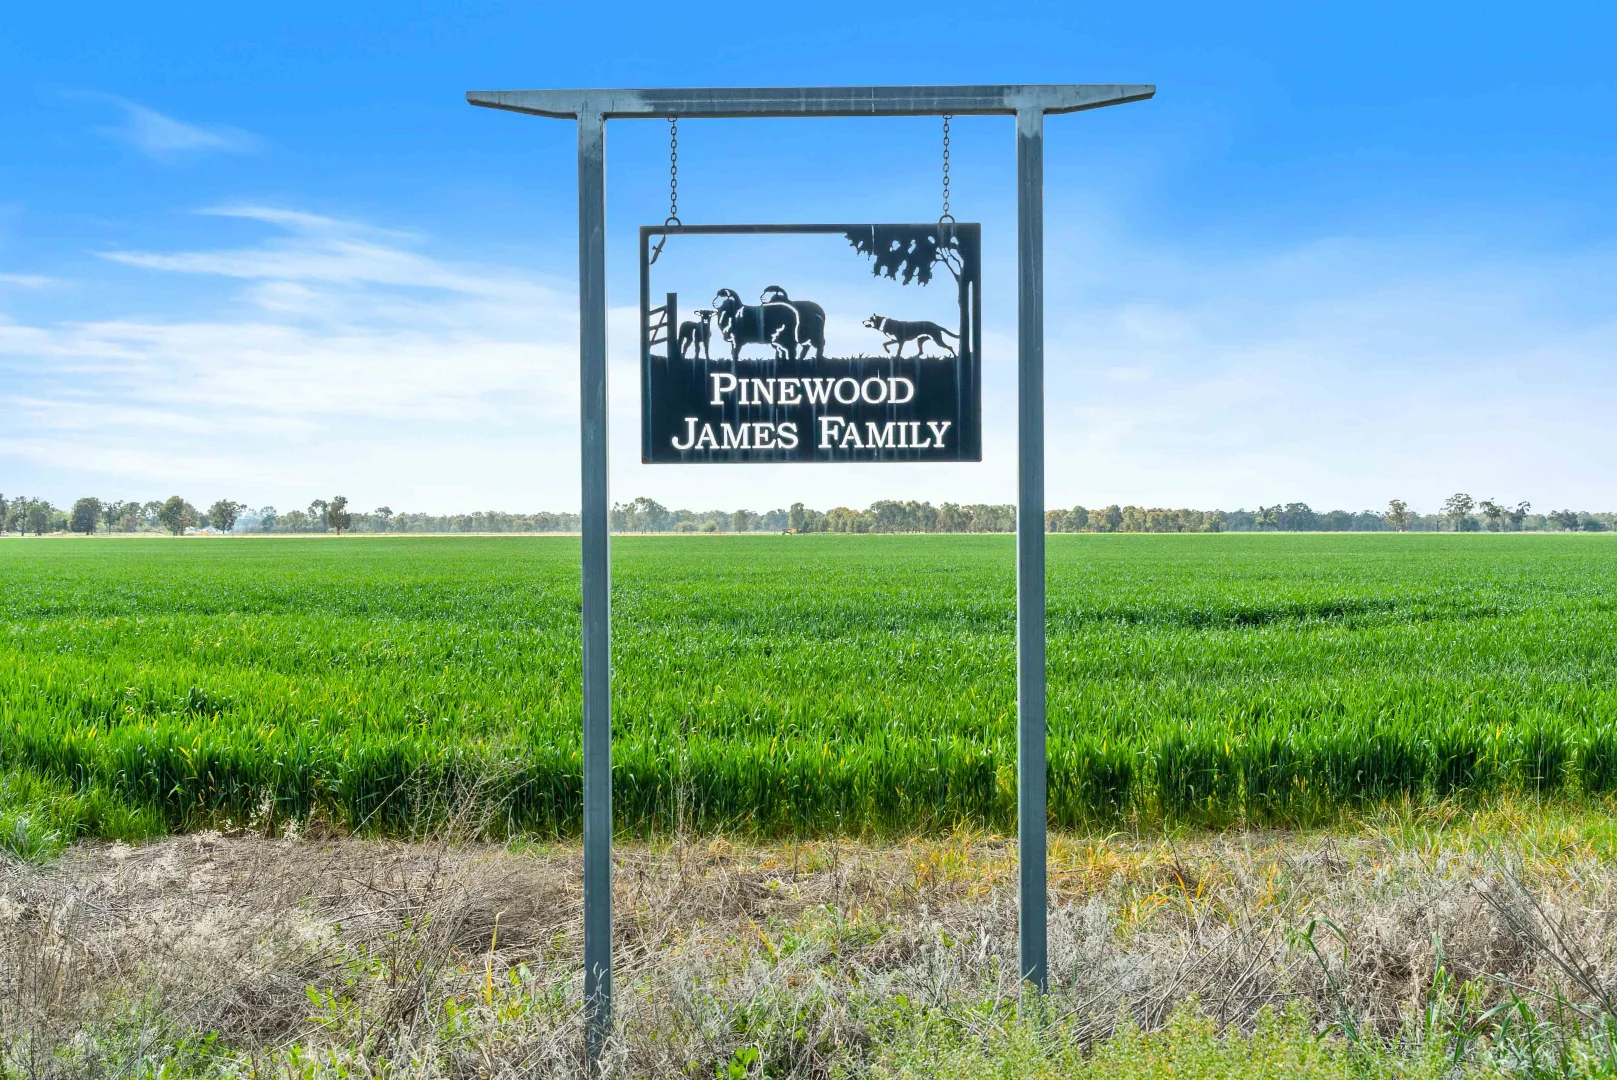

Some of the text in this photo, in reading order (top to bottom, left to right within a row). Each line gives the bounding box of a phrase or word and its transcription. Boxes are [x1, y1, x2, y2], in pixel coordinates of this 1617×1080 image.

[709, 372, 915, 406] PINEWOOD
[671, 415, 952, 450] JAMES FAMILY
